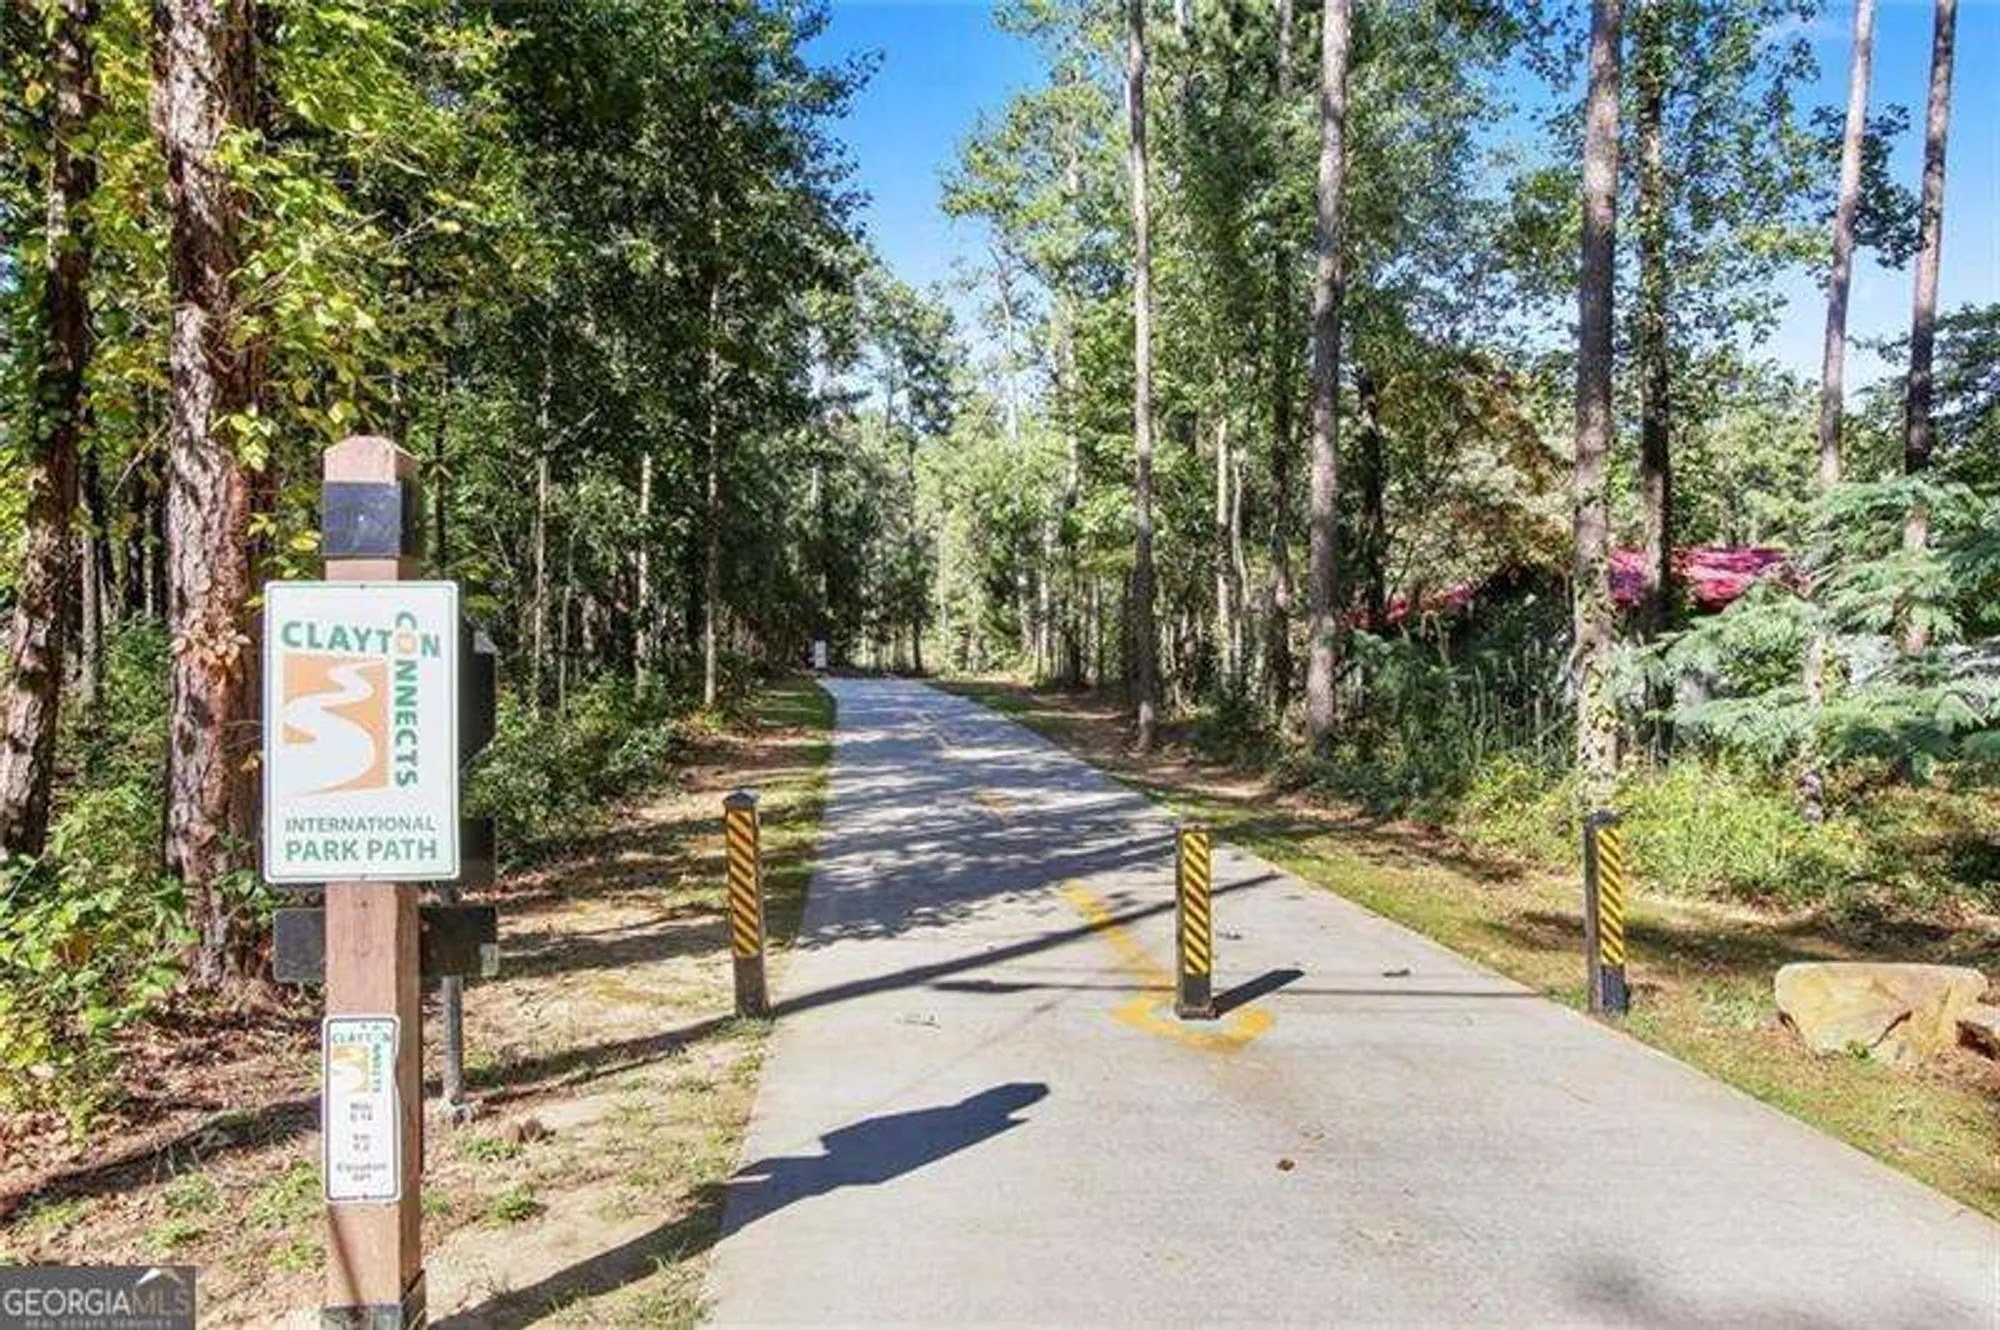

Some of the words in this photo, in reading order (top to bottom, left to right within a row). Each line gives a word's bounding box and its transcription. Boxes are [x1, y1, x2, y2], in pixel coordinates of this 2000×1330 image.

[281, 620, 441, 656] CLAYTON
[394, 610, 419, 788] CONNECTS
[285, 816, 435, 833] INTERNATIONAL
[285, 839, 360, 862] PARK
[367, 838, 436, 862] PATH
